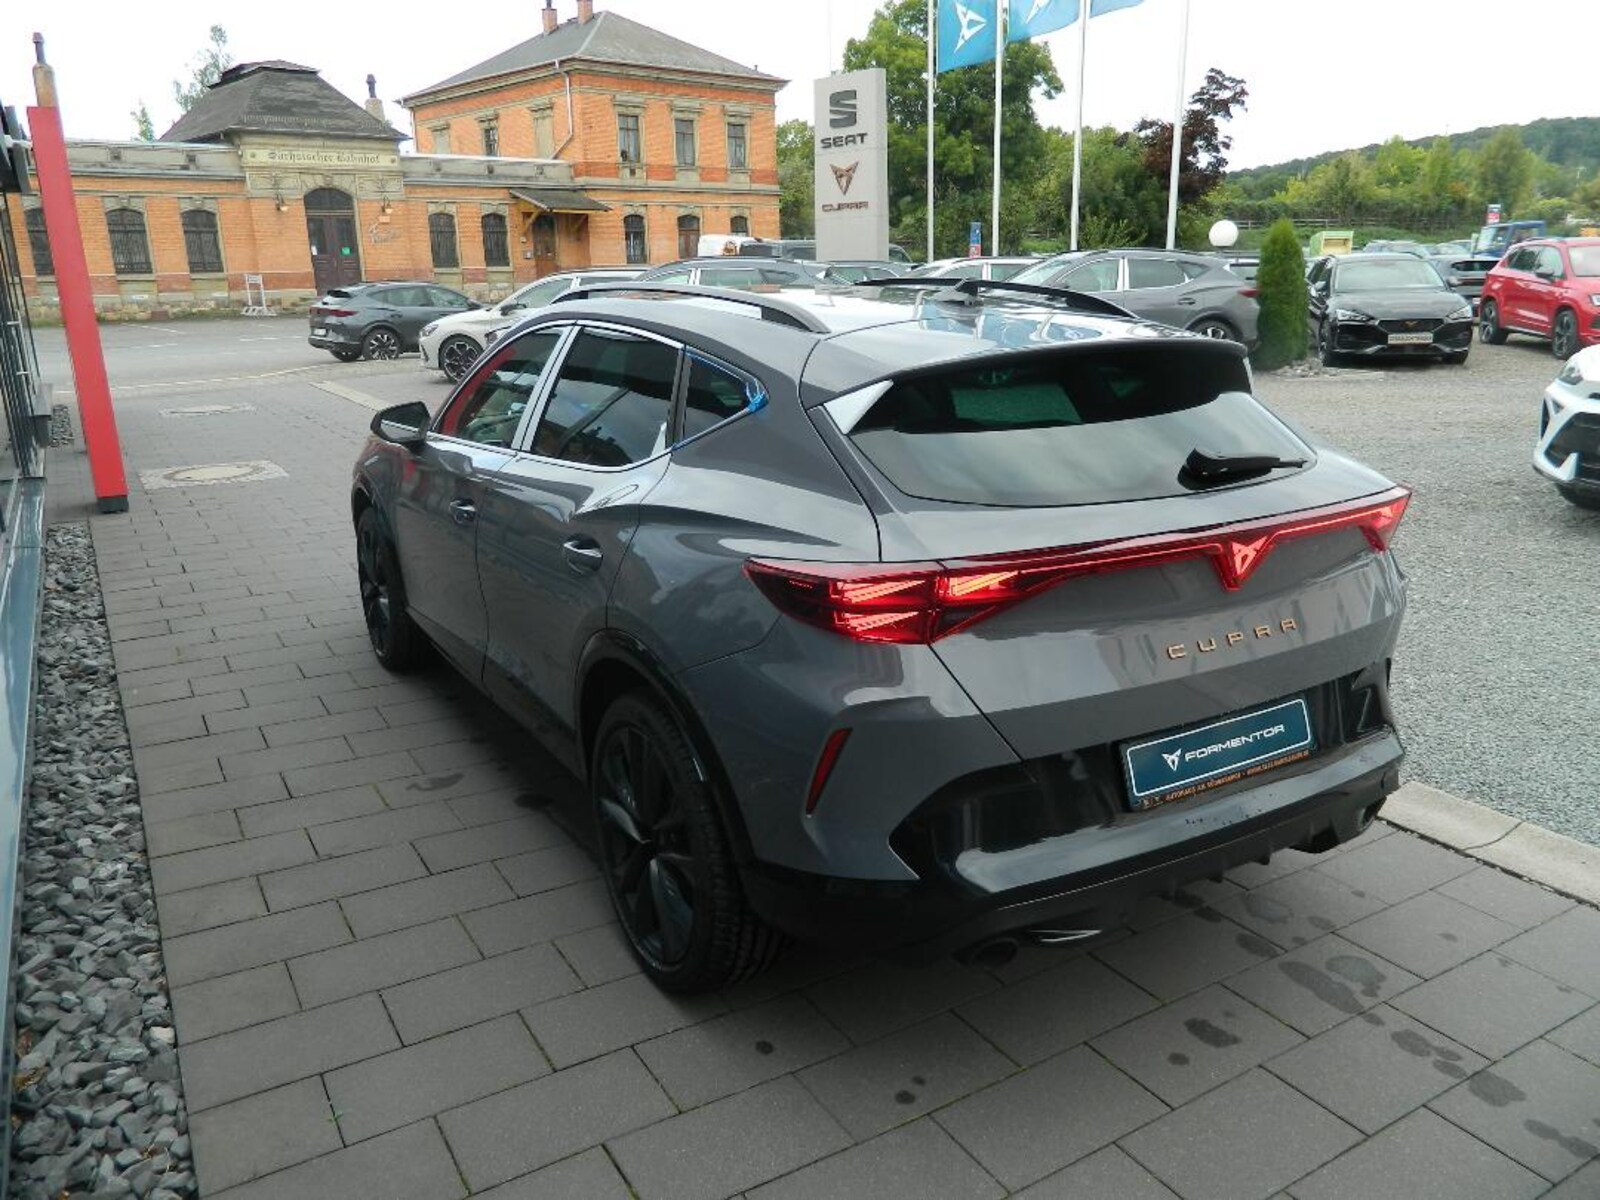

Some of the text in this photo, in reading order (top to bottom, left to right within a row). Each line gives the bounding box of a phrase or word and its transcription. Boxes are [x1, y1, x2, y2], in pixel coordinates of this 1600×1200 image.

[820, 133, 868, 148] SEAT
[822, 201, 868, 212] CUPRA
[1166, 616, 1298, 660] CUPRA
[1185, 724, 1285, 762] FORMENTOR
